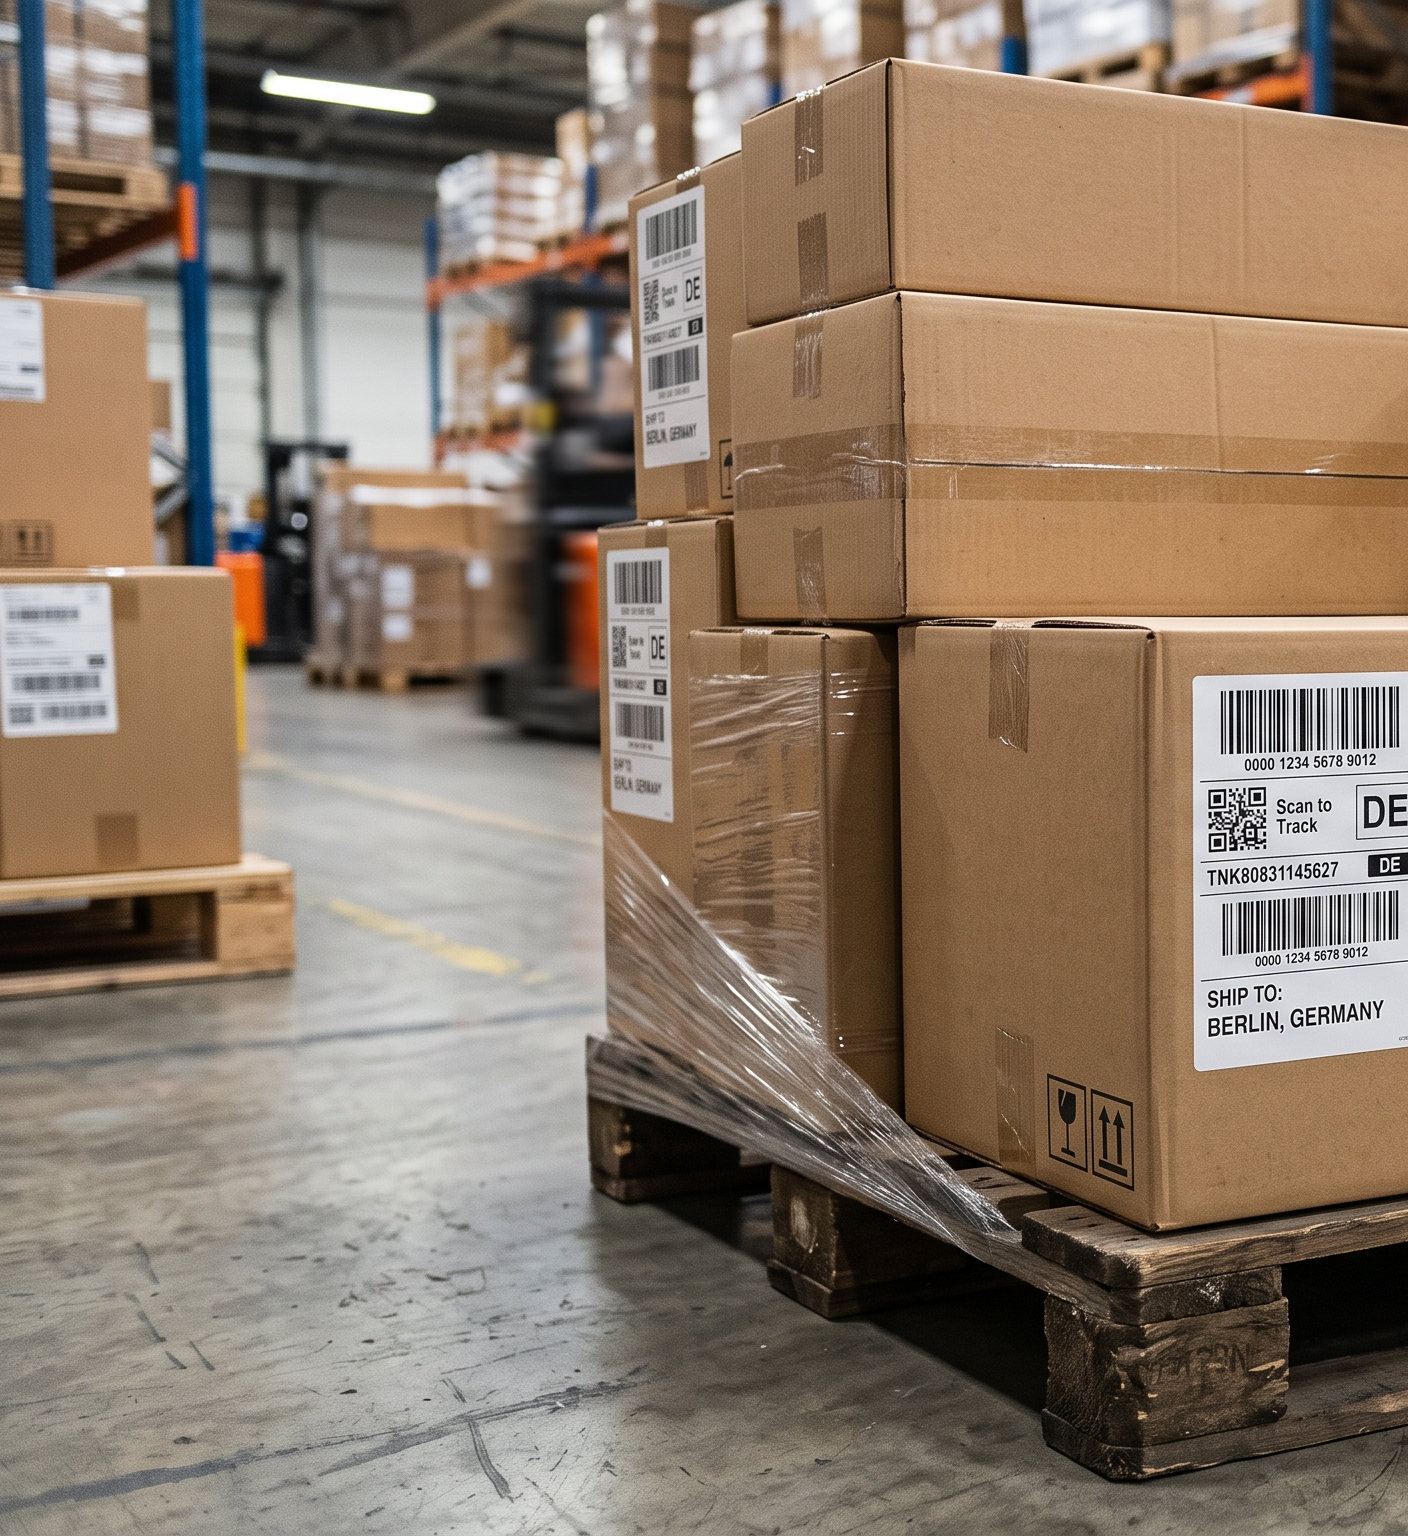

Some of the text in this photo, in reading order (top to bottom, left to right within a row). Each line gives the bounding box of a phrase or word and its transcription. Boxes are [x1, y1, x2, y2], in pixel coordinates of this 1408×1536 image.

[685, 276, 701, 303] DE
[651, 635, 666, 660] DE
[1244, 753, 1376, 772] 0000 1234 5678 9012
[1276, 798, 1332, 815] Scan to
[1363, 794, 1408, 829] DE
[1277, 817, 1318, 835] Track
[1207, 856, 1401, 887] TNK80831145627 DE
[1255, 946, 1369, 967] 0000 1234 5678 9012
[1207, 984, 1282, 1009] SHIP TO:
[1208, 1000, 1384, 1038] BERLIN, GERMANY
